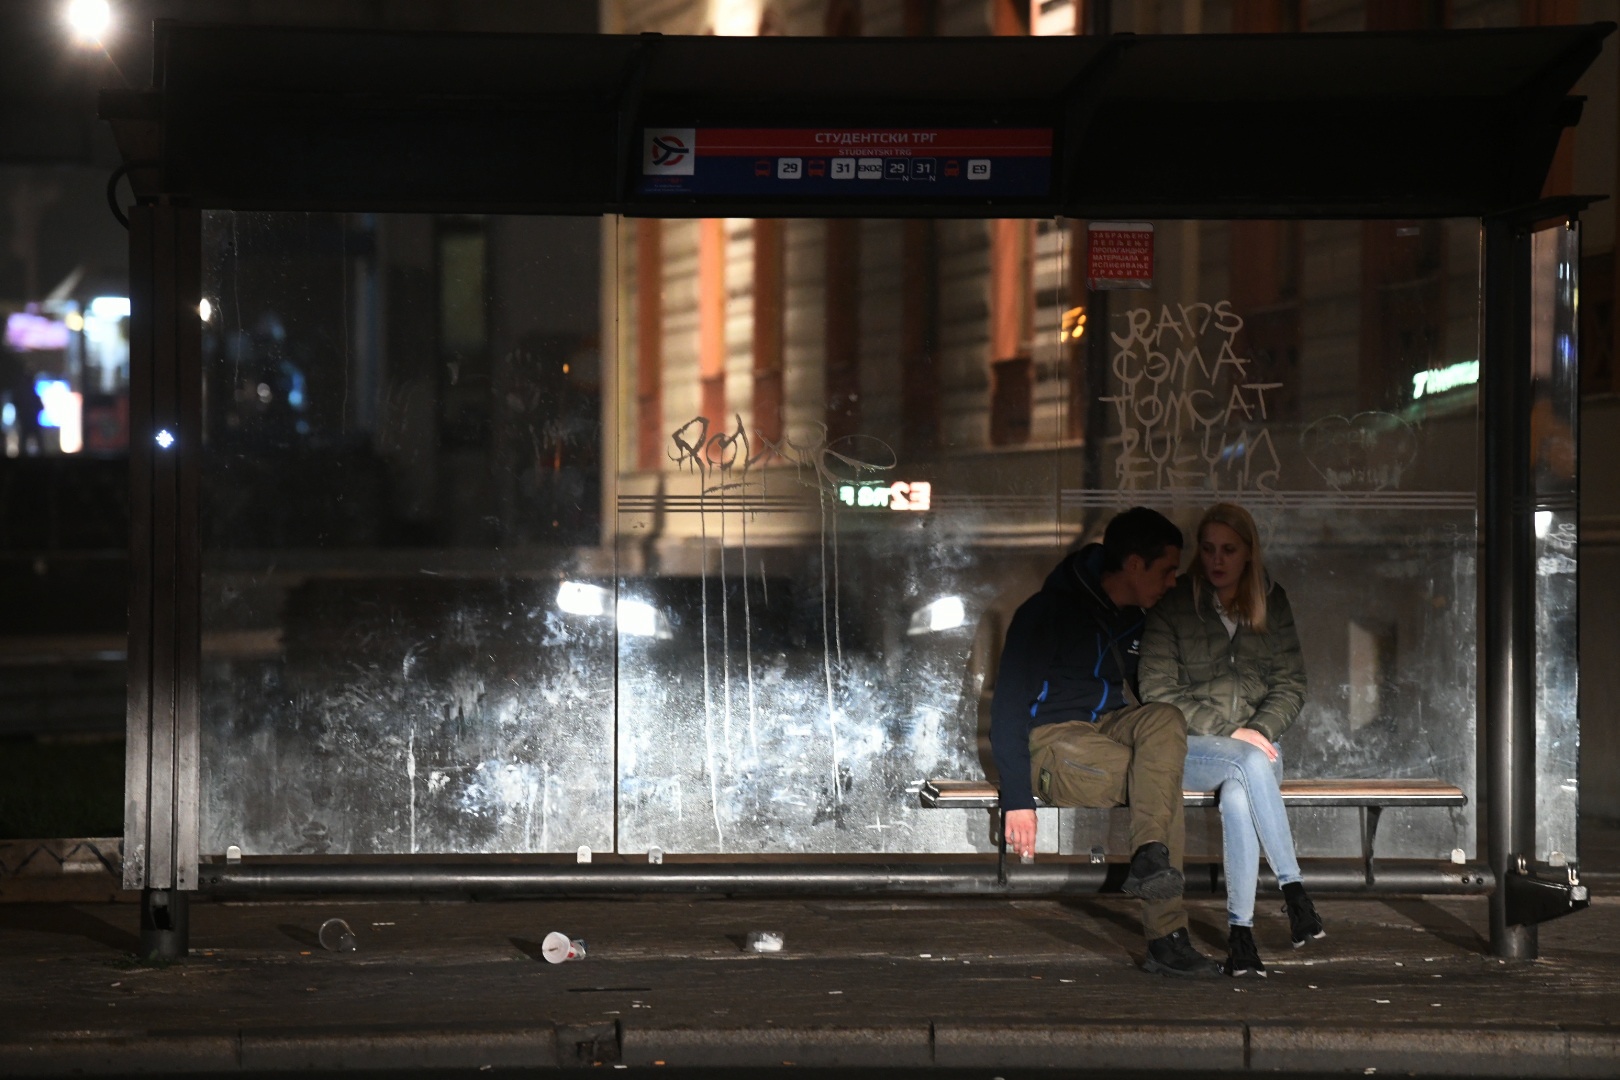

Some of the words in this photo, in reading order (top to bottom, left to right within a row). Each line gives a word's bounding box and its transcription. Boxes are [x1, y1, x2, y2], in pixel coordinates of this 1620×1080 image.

[815, 132, 909, 145] СТУДЕНТСКИ
[911, 132, 938, 144] ТРГ
[838, 148, 893, 156] STUDENTSKI
[894, 148, 912, 156] TRG
[782, 163, 798, 174] 29
[835, 163, 850, 174] 31
[889, 163, 905, 174] 29
[916, 163, 931, 174] 31
[972, 164, 987, 174] E9
[1093, 232, 1150, 240] ЗАБРАЊЕНО
[1091, 269, 1150, 277] ГРАФИТА
